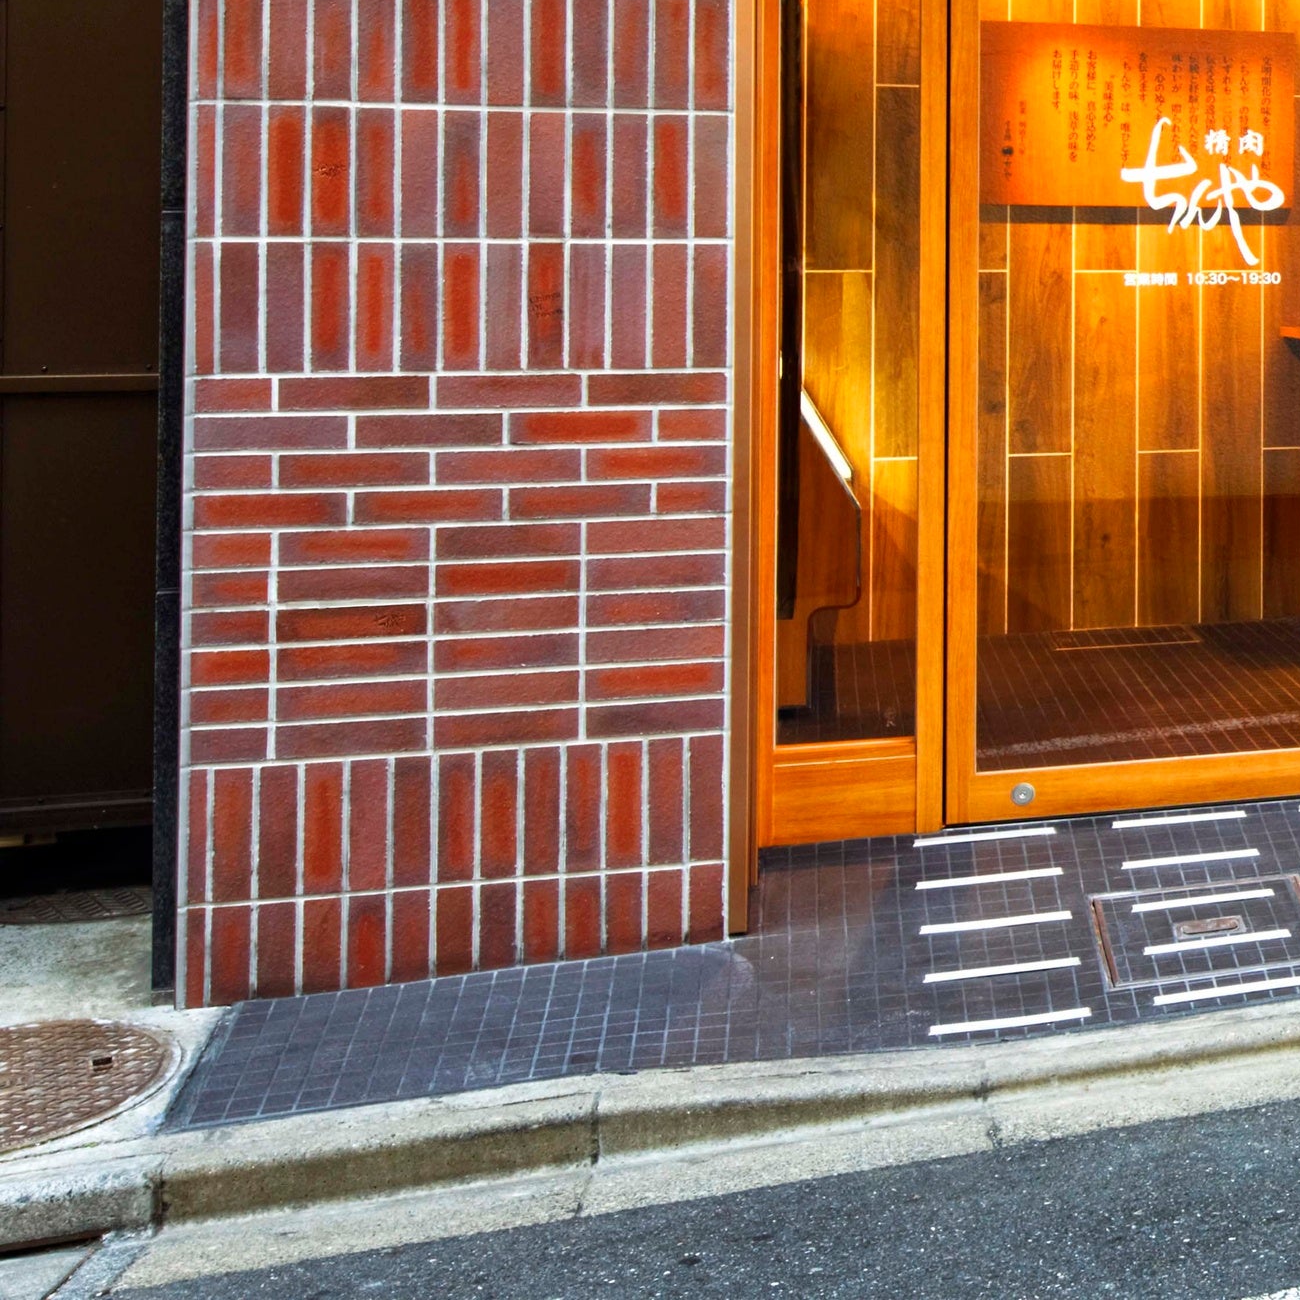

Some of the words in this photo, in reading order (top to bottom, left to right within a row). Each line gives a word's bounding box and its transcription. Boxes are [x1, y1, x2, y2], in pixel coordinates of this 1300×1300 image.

[1203, 129, 1265, 157] 精肉
[1120, 116, 1286, 267] ちんや
[1123, 272, 1178, 286] 営業時間
